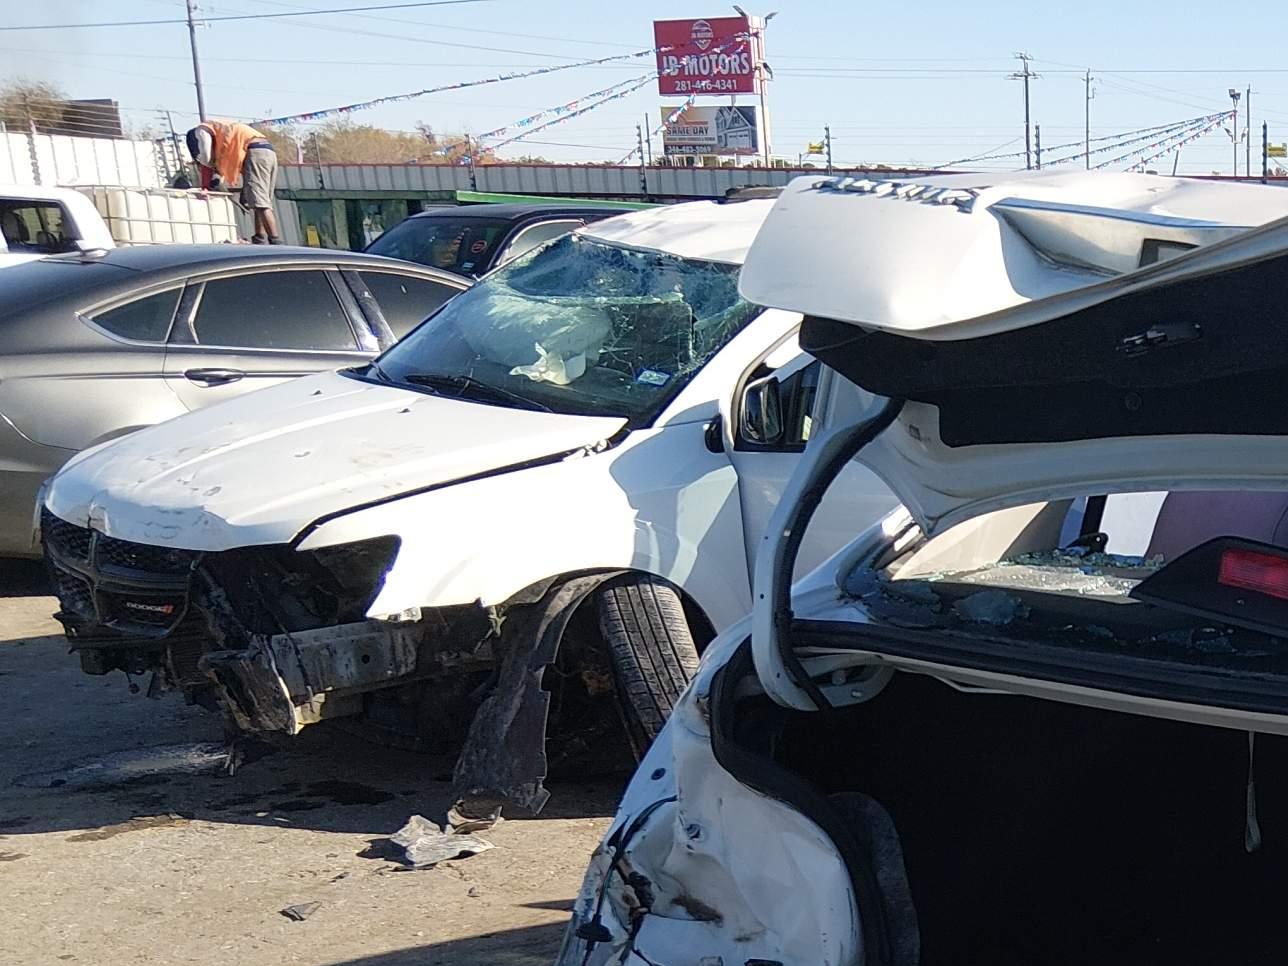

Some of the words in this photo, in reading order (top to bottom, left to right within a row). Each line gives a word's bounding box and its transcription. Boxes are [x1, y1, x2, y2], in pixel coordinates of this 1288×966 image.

[684, 53, 750, 76] MOTORS
[667, 126, 691, 135] SAME
[693, 126, 709, 135] DAY
